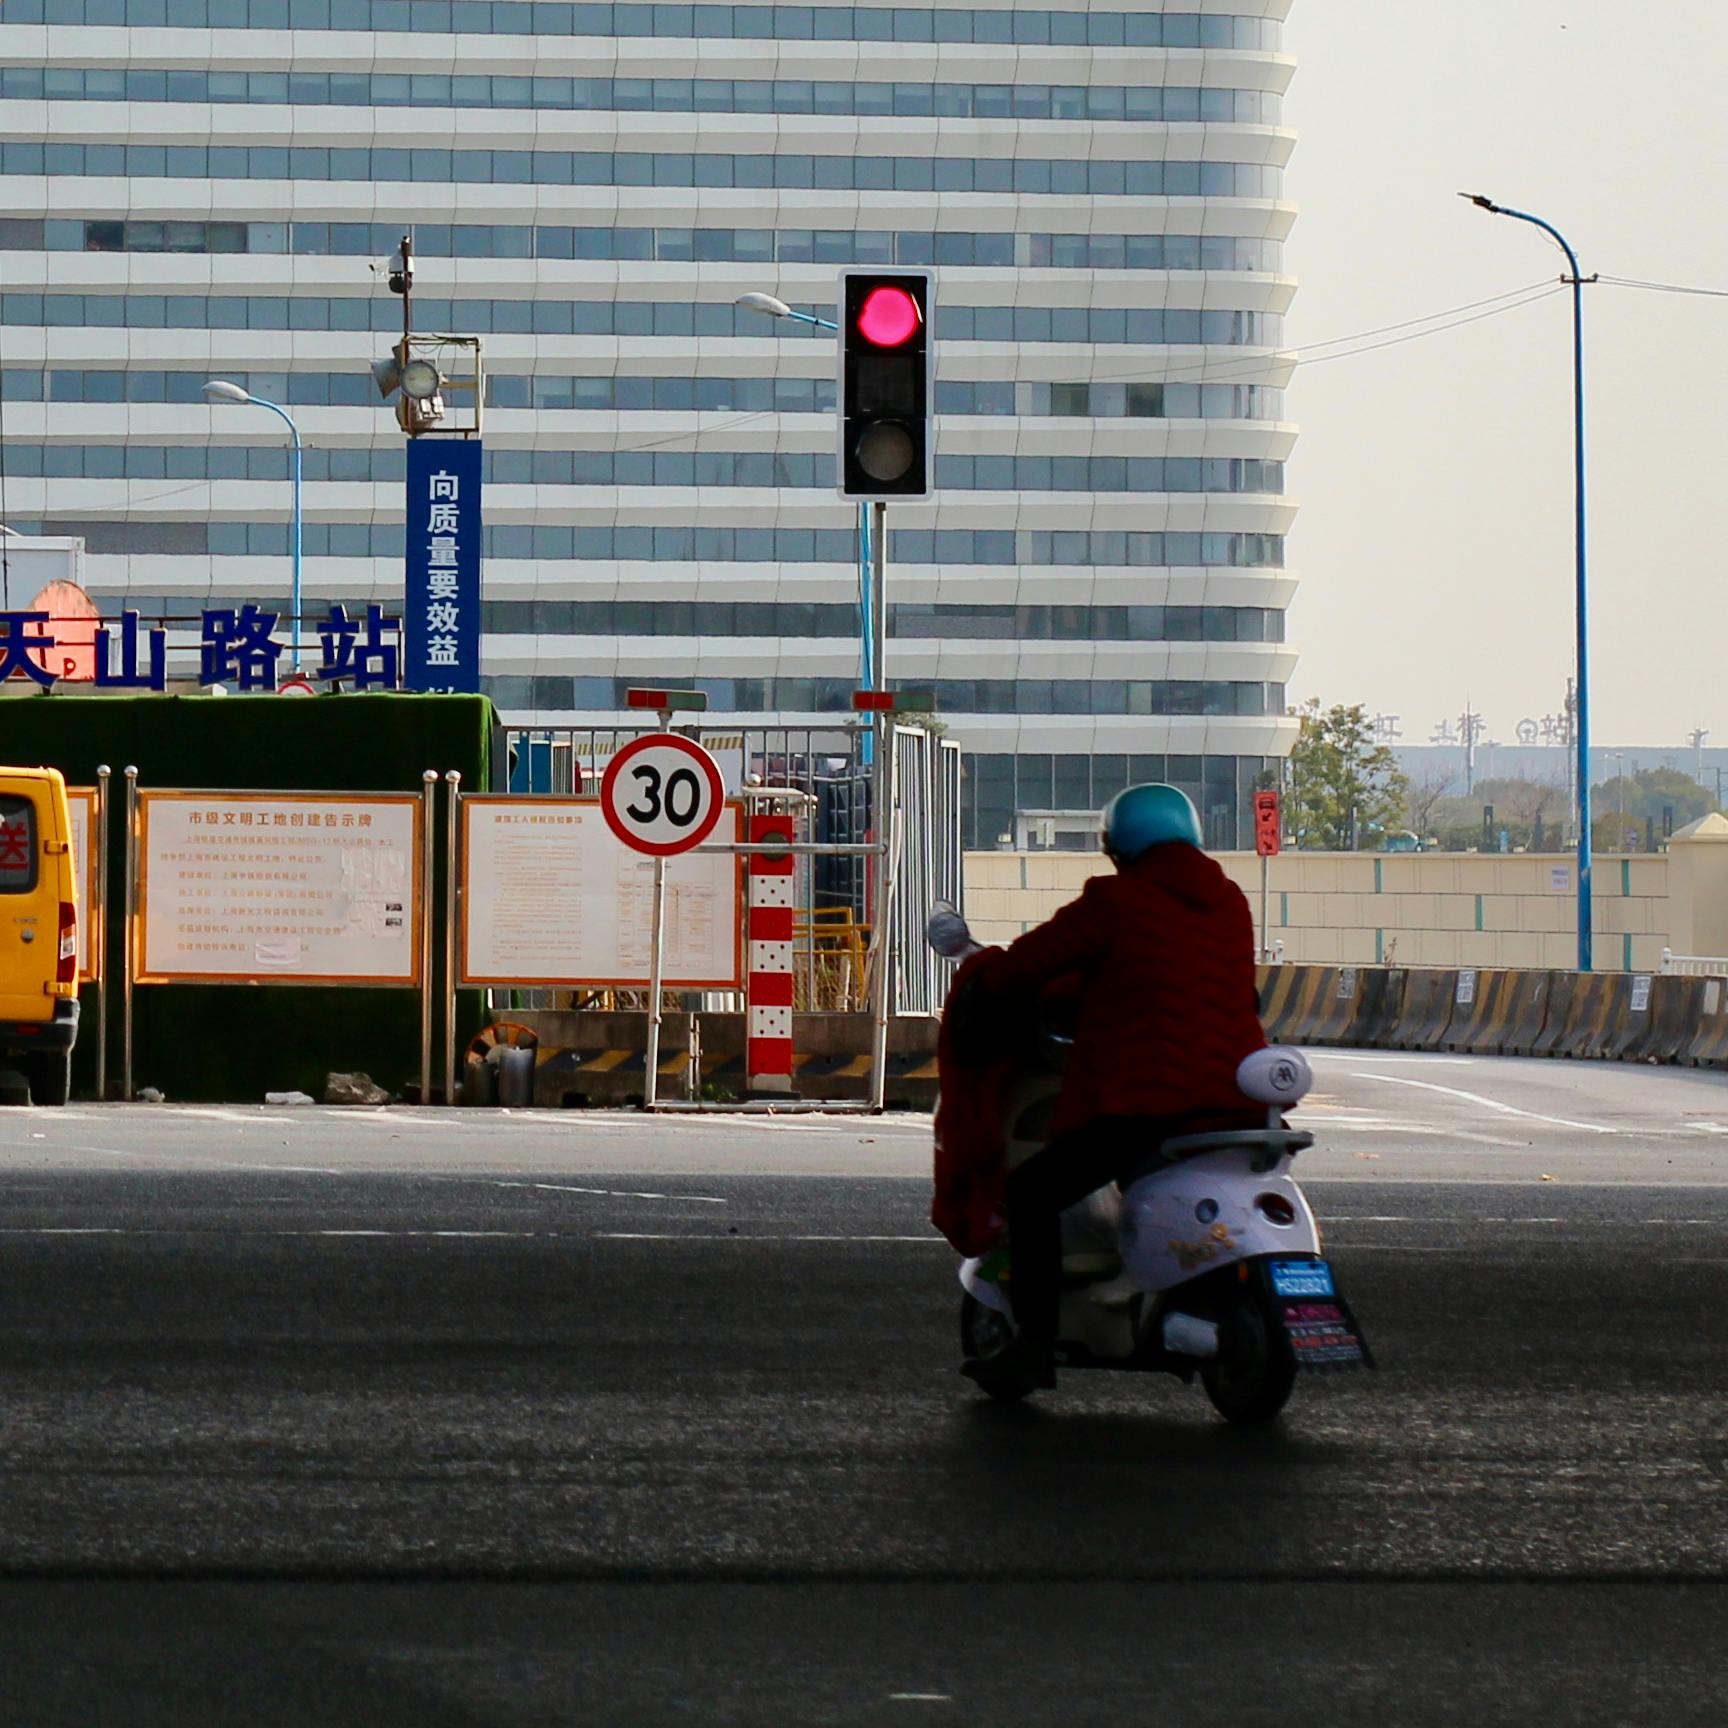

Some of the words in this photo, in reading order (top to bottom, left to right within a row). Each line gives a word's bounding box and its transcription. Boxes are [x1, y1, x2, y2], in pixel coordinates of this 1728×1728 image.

[426, 470, 460, 666] 向质量要效益
[189, 812, 373, 828] 市级文明工地创建告示牌
[625, 764, 701, 828] 30
